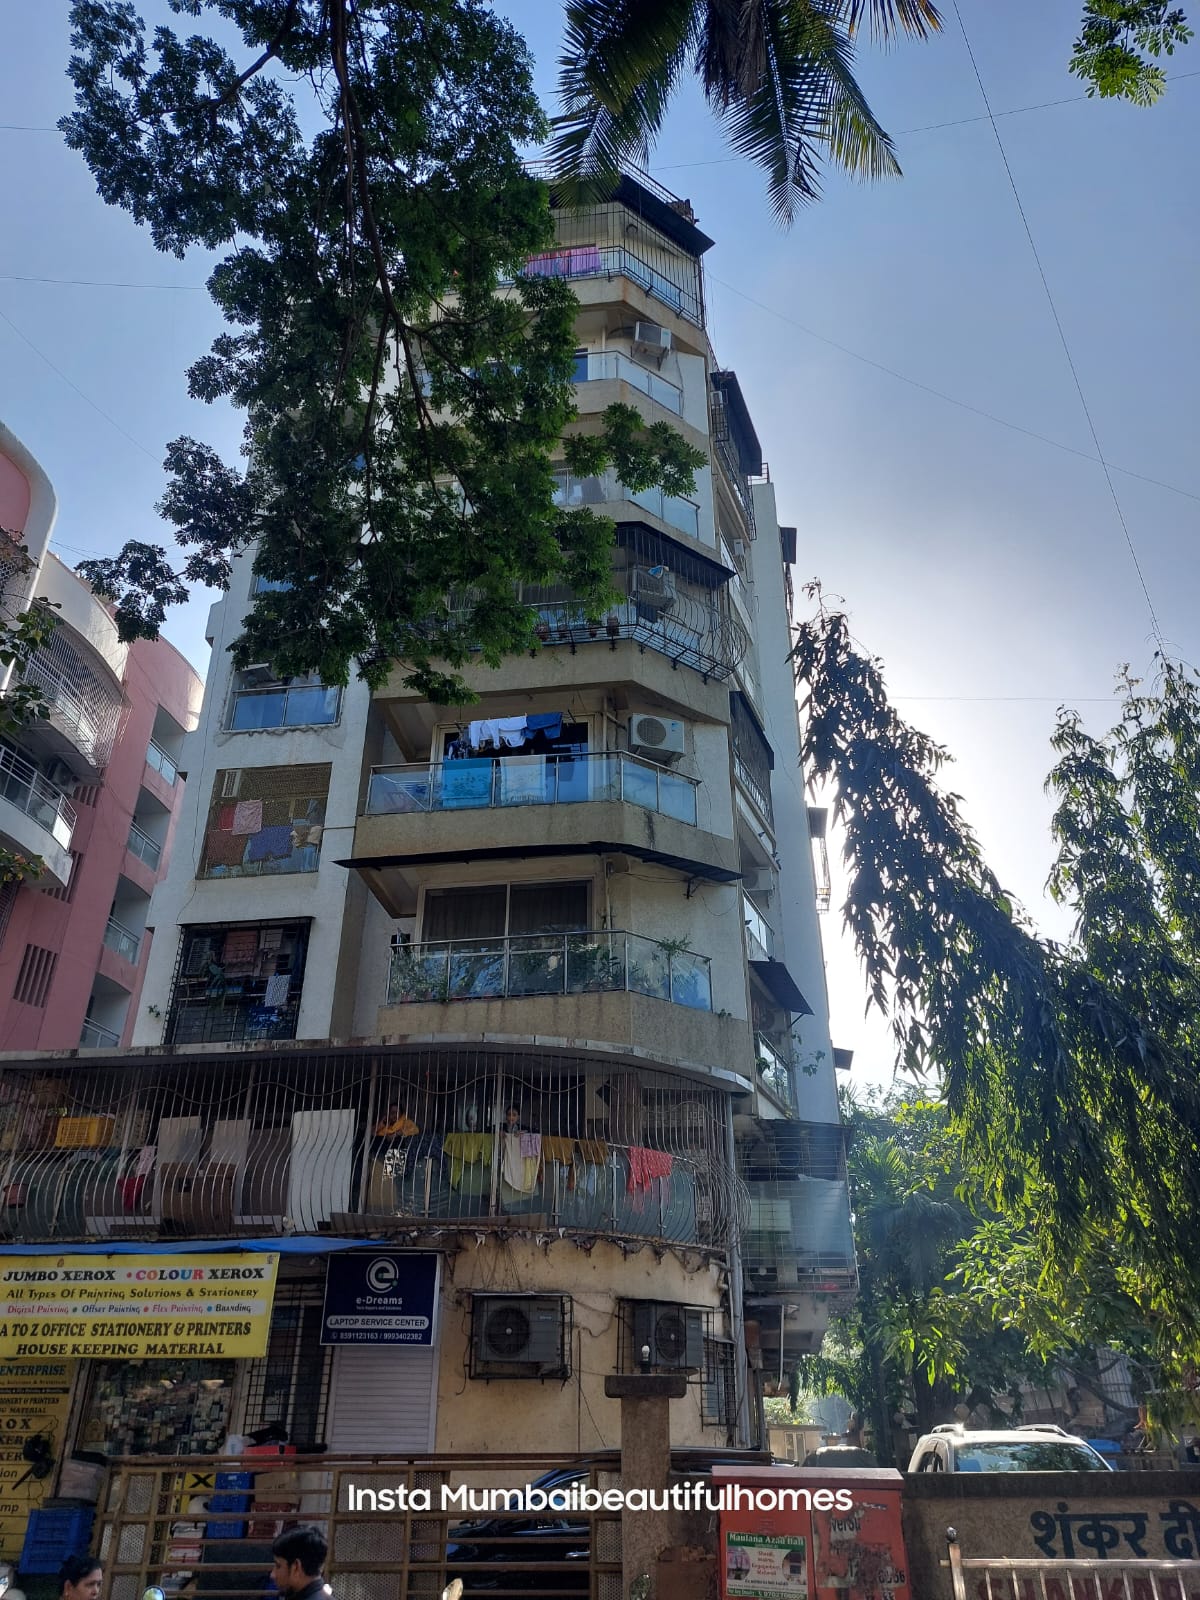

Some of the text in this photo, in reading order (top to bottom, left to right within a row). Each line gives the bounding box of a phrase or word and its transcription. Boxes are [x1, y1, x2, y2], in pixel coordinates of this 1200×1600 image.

[3, 1268, 265, 1281] JUMBO XEROX COLOUR XEROX
[6, 1289, 24, 1298] All
[60, 1288, 75, 1298] Of
[185, 1288, 195, 1297] &
[356, 1296, 403, 1305] e-Dreams
[329, 1318, 426, 1327] LAPTOP SERVICE CENTER
[0, 1322, 251, 1337] A TO Z OFFICE STATIONERY & PRINTERS
[16, 1343, 224, 1355] HOUSE KEEPING MATERIAL
[1030, 1502, 1149, 1560] शंकर
[729, 1533, 763, 1543] Maulana
